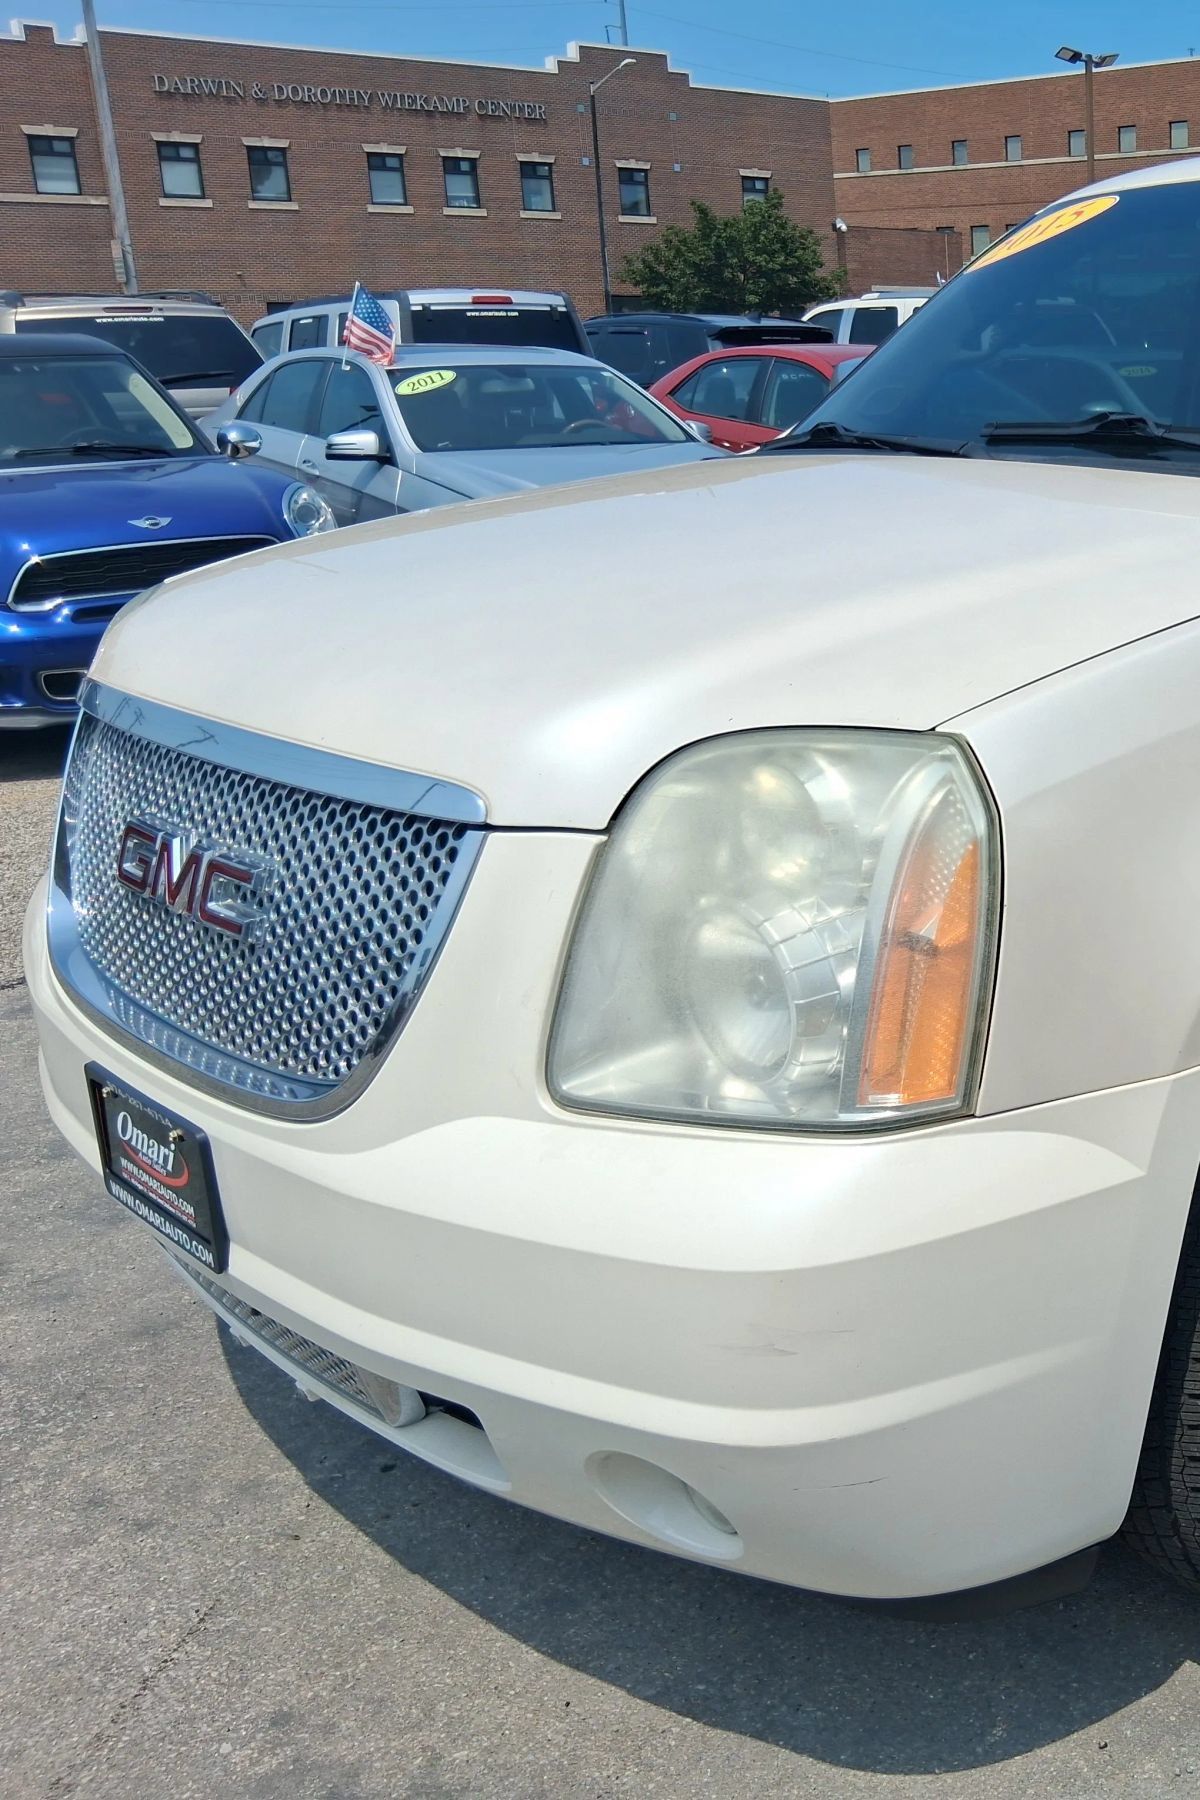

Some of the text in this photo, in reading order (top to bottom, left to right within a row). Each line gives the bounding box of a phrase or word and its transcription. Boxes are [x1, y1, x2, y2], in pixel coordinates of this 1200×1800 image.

[153, 74, 546, 121] DARWIN & DOROTHY WIEKAMP CENTER
[407, 371, 446, 392] 2011
[117, 819, 258, 937] GMC
[117, 1111, 176, 1173] Omari
[120, 1157, 195, 1217] WWW.OMARIAUTO.COM
[109, 1179, 215, 1268] WWW.OMARIAUTO.COM
